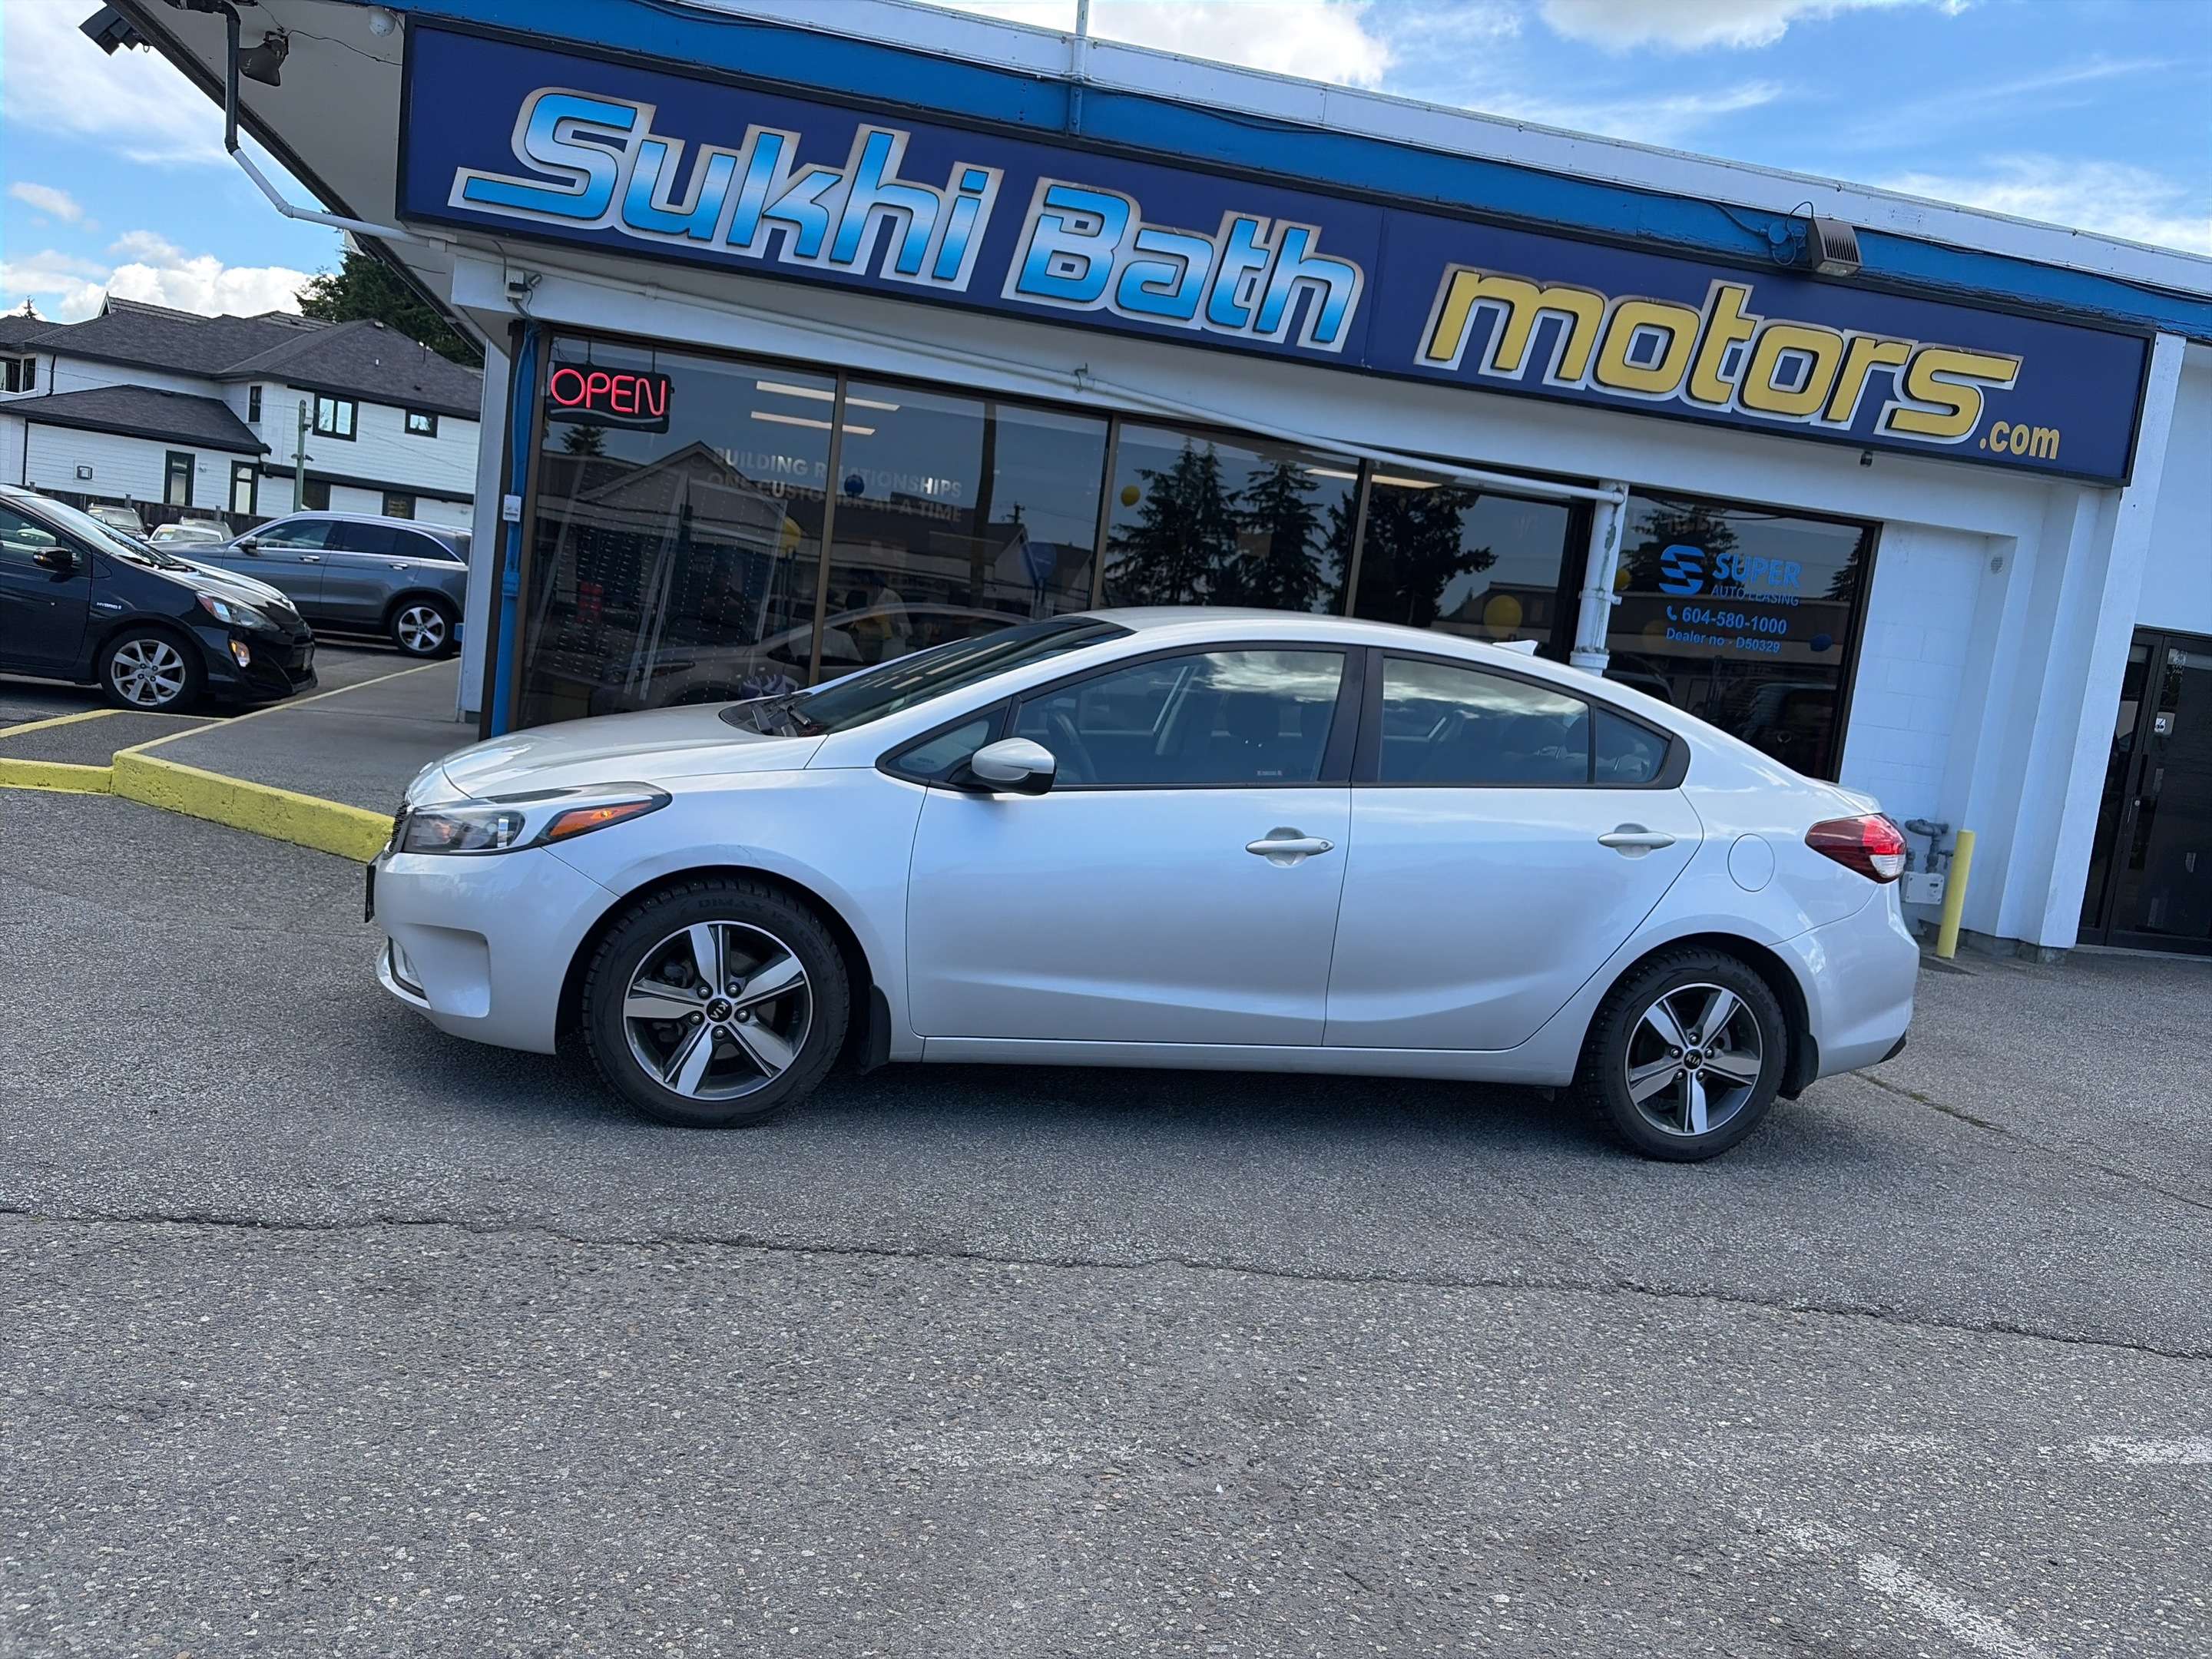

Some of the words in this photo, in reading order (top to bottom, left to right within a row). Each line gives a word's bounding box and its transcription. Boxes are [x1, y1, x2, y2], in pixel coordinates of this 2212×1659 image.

[448, 86, 1005, 293] Sukhi
[1001, 176, 1365, 353] Bath
[1414, 263, 2024, 443] motors
[551, 369, 667, 416] OPEN
[713, 446, 808, 476] BUILDING
[814, 462, 962, 498] RLATIONSHIPS
[1712, 552, 1802, 588] SUPER
[1711, 584, 1746, 599] AUTO
[1748, 591, 1800, 607] LEASING
[1665, 628, 1708, 644] Dealer
[1709, 635, 1725, 646] no
[1682, 607, 1788, 635] 604-580-1000
[1686, 1053, 1700, 1066] KIA
